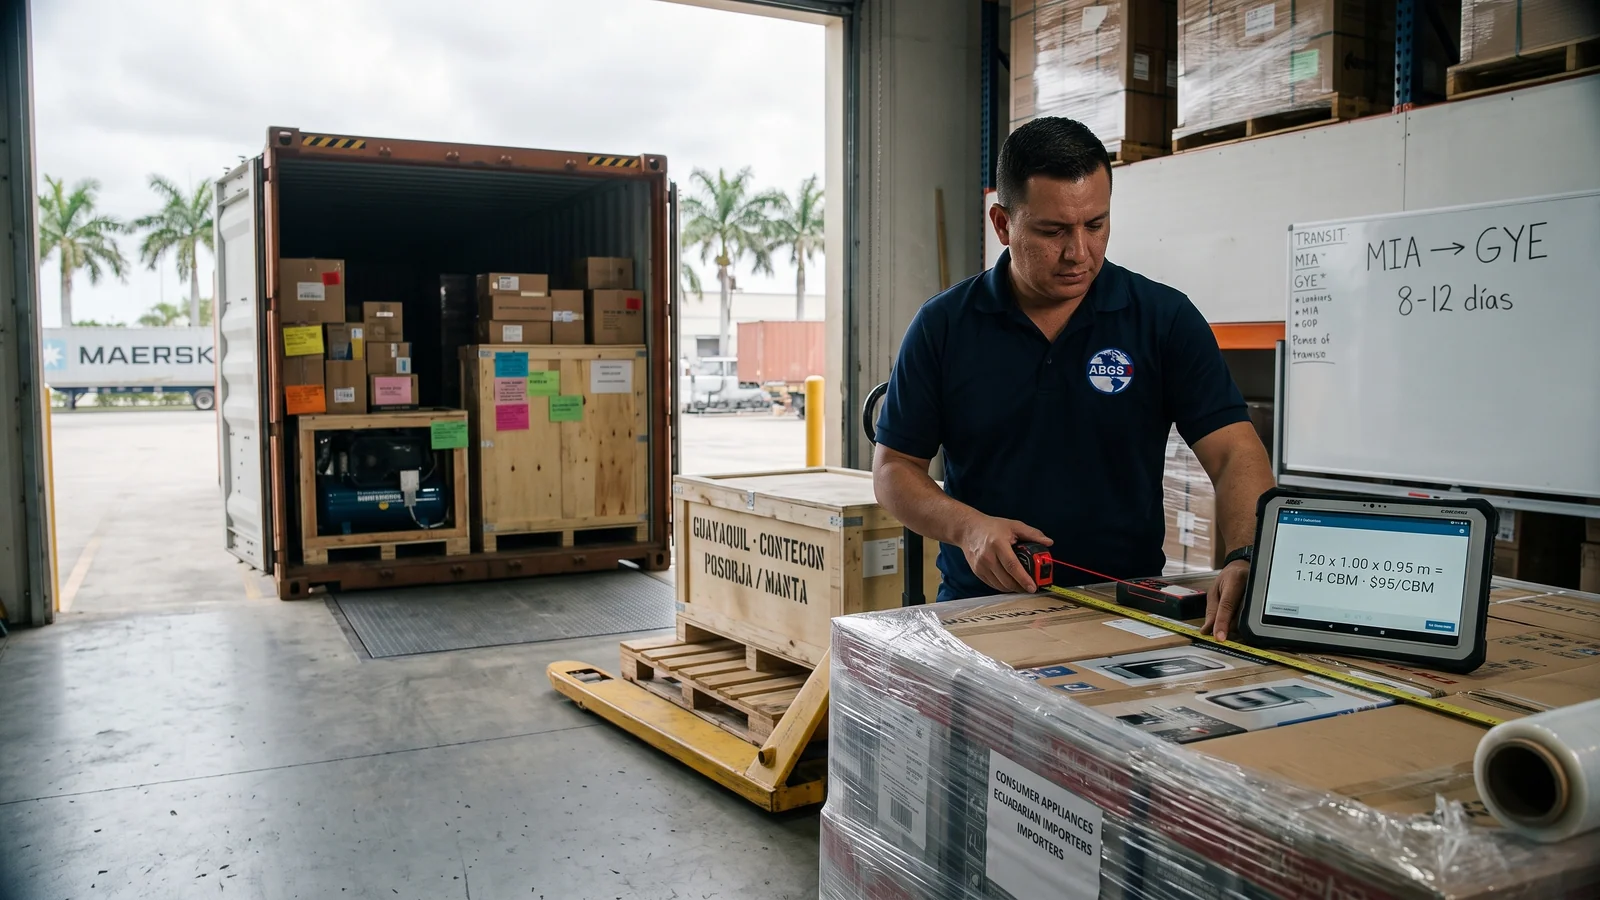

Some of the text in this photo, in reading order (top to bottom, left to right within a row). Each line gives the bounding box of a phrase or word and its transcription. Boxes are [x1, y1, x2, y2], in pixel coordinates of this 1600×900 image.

[1294, 227, 1346, 246] TRANSIT
[1366, 222, 1548, 271] MIA GYE
[1295, 253, 1318, 267] MIA
[1397, 284, 1514, 316] 8-12 días
[79, 346, 214, 364] MAERSK
[1088, 365, 1125, 375] ABGS
[693, 516, 750, 552] GUAYAQUIL
[759, 532, 825, 571] CONTECON
[704, 552, 753, 588] POSORJA
[765, 569, 808, 605] MANTA
[1298, 553, 1325, 566] 1.20
[1329, 558, 1336, 567] x
[1341, 557, 1368, 570] 1.00
[1372, 562, 1379, 571] x
[1383, 560, 1413, 574] 0.95
[1417, 566, 1431, 575] m
[1296, 570, 1323, 583] 1.14
[1327, 572, 1358, 586] CBM
[1369, 576, 1435, 594] $95/CBM
[995, 770, 1094, 835] CONSUMER APPLIANCES
[1016, 822, 1064, 861] IMPORTERS
[1042, 816, 1093, 857] IMPORTERS
